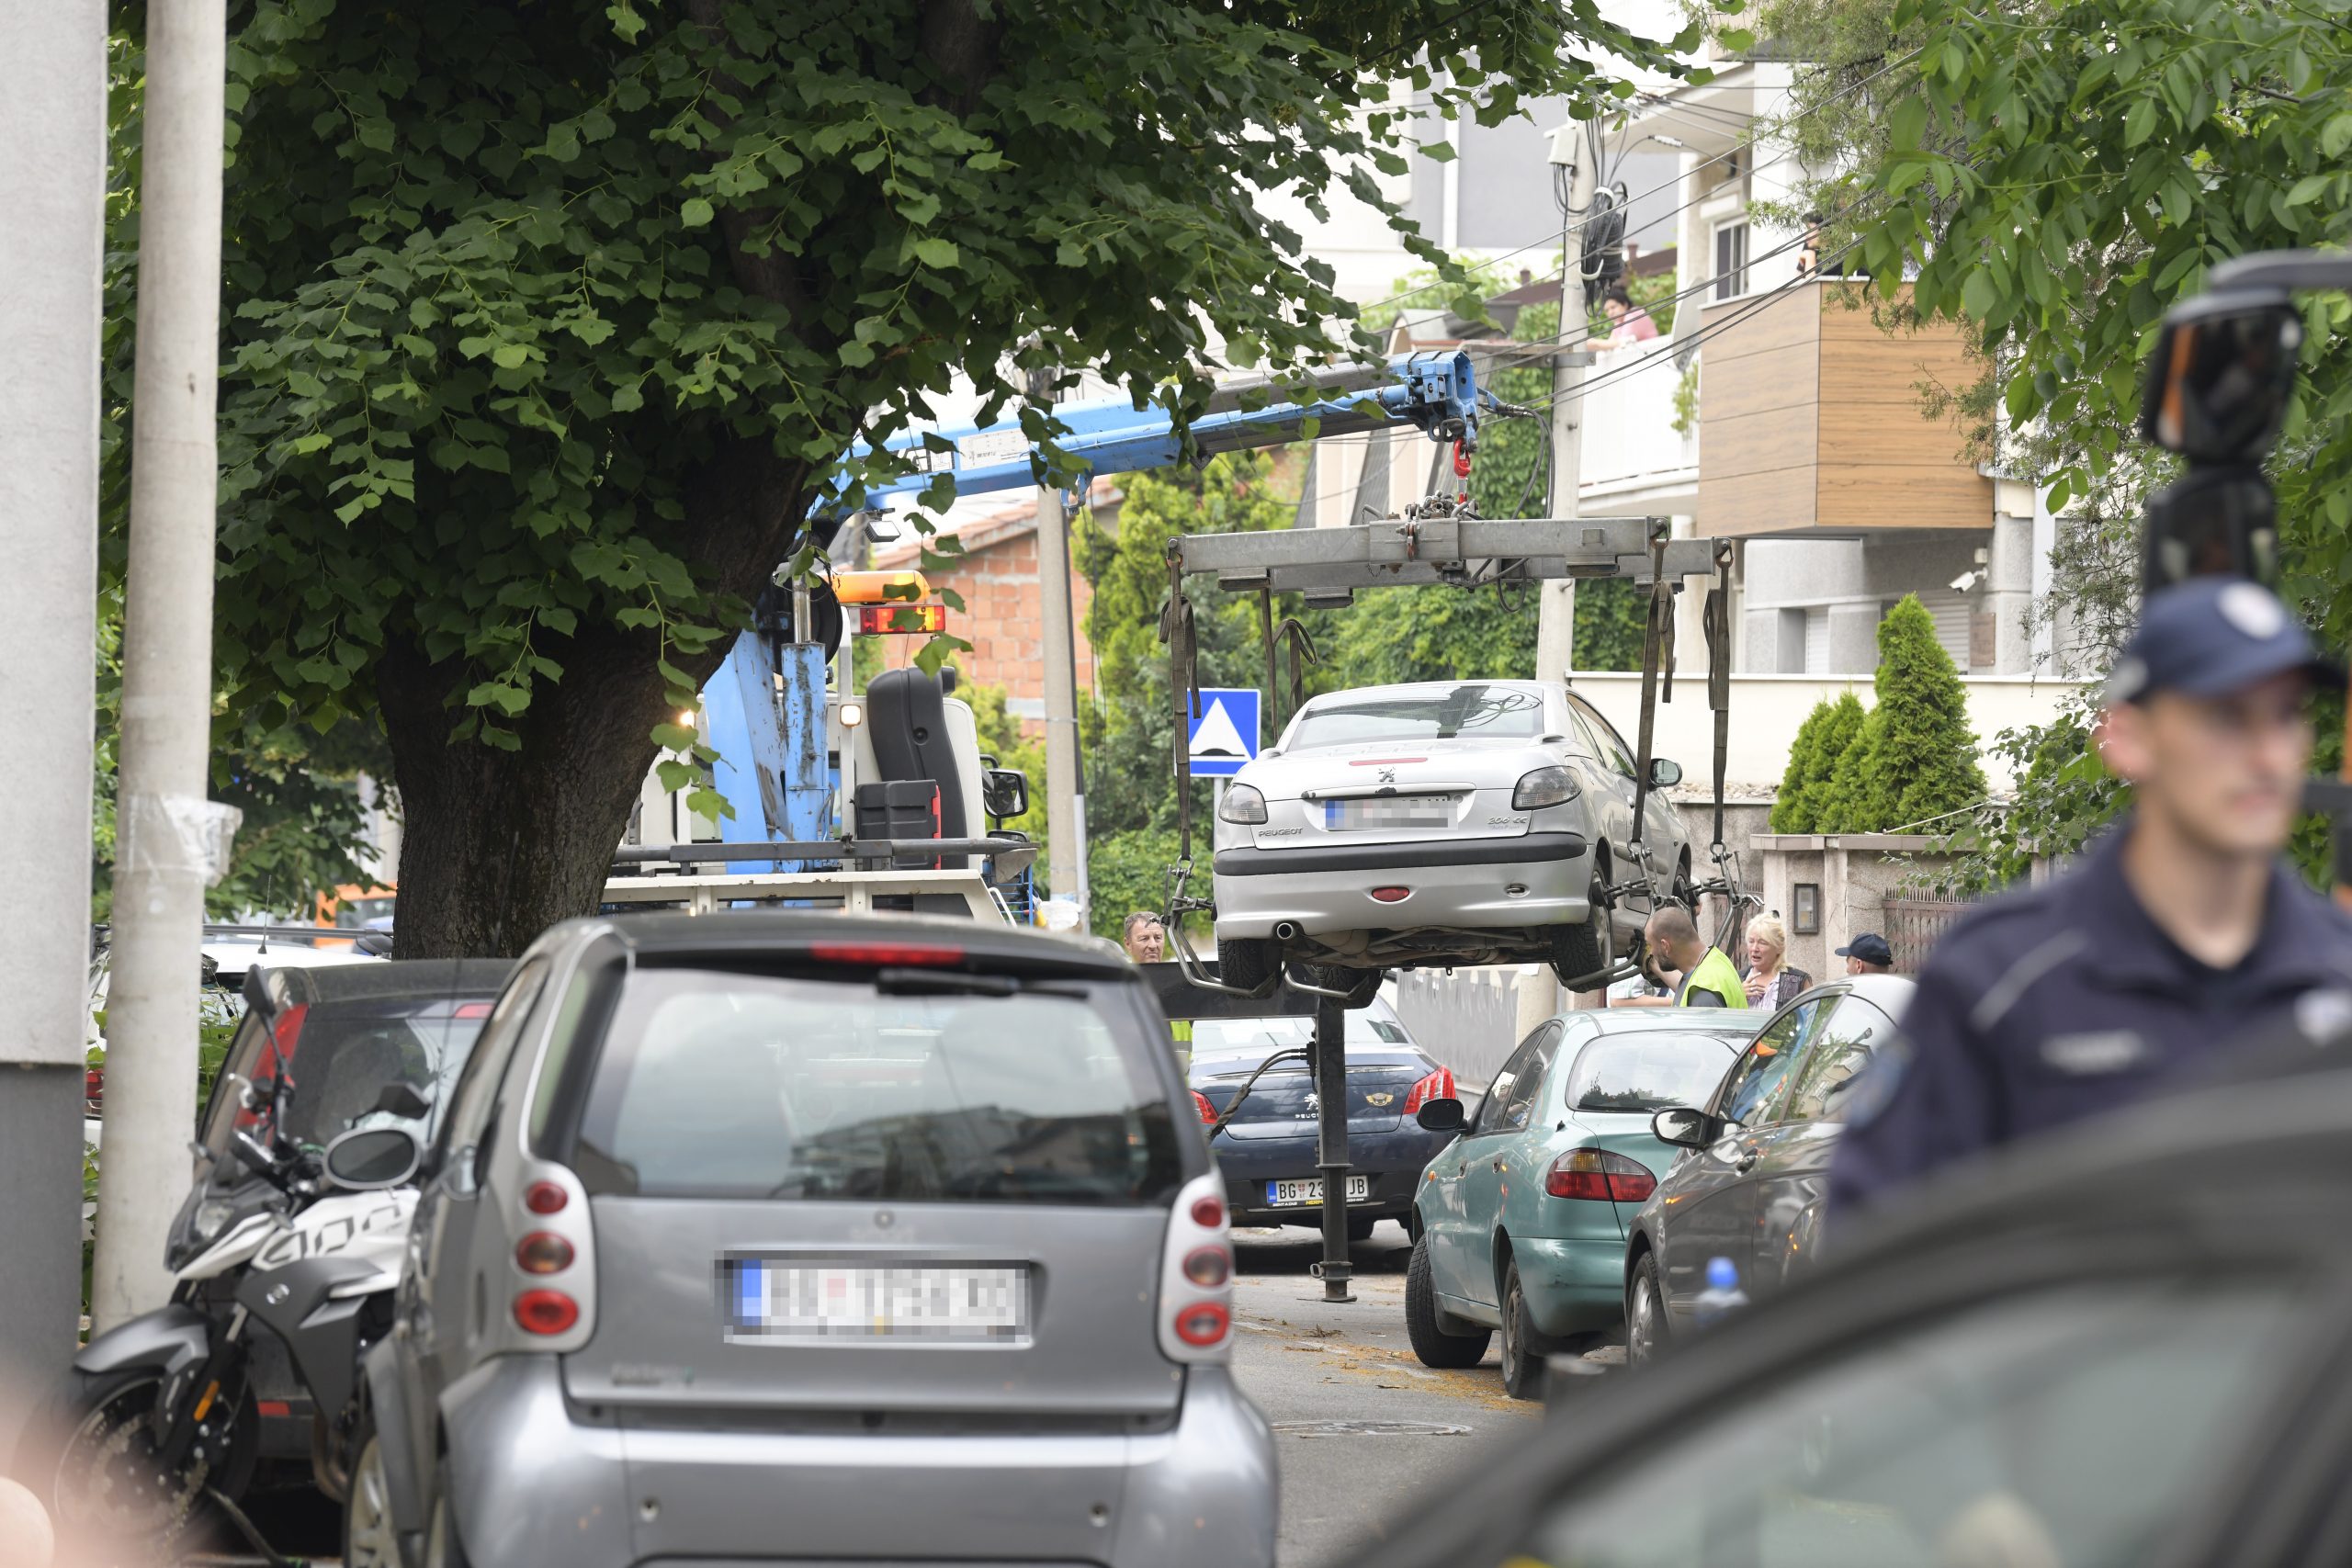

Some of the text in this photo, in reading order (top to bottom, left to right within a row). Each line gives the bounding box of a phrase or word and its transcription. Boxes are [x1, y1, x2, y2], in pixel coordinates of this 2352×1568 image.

[1258, 828, 1303, 837] PEUGEOT
[1279, 1179, 1365, 1200] BG 23 JB
